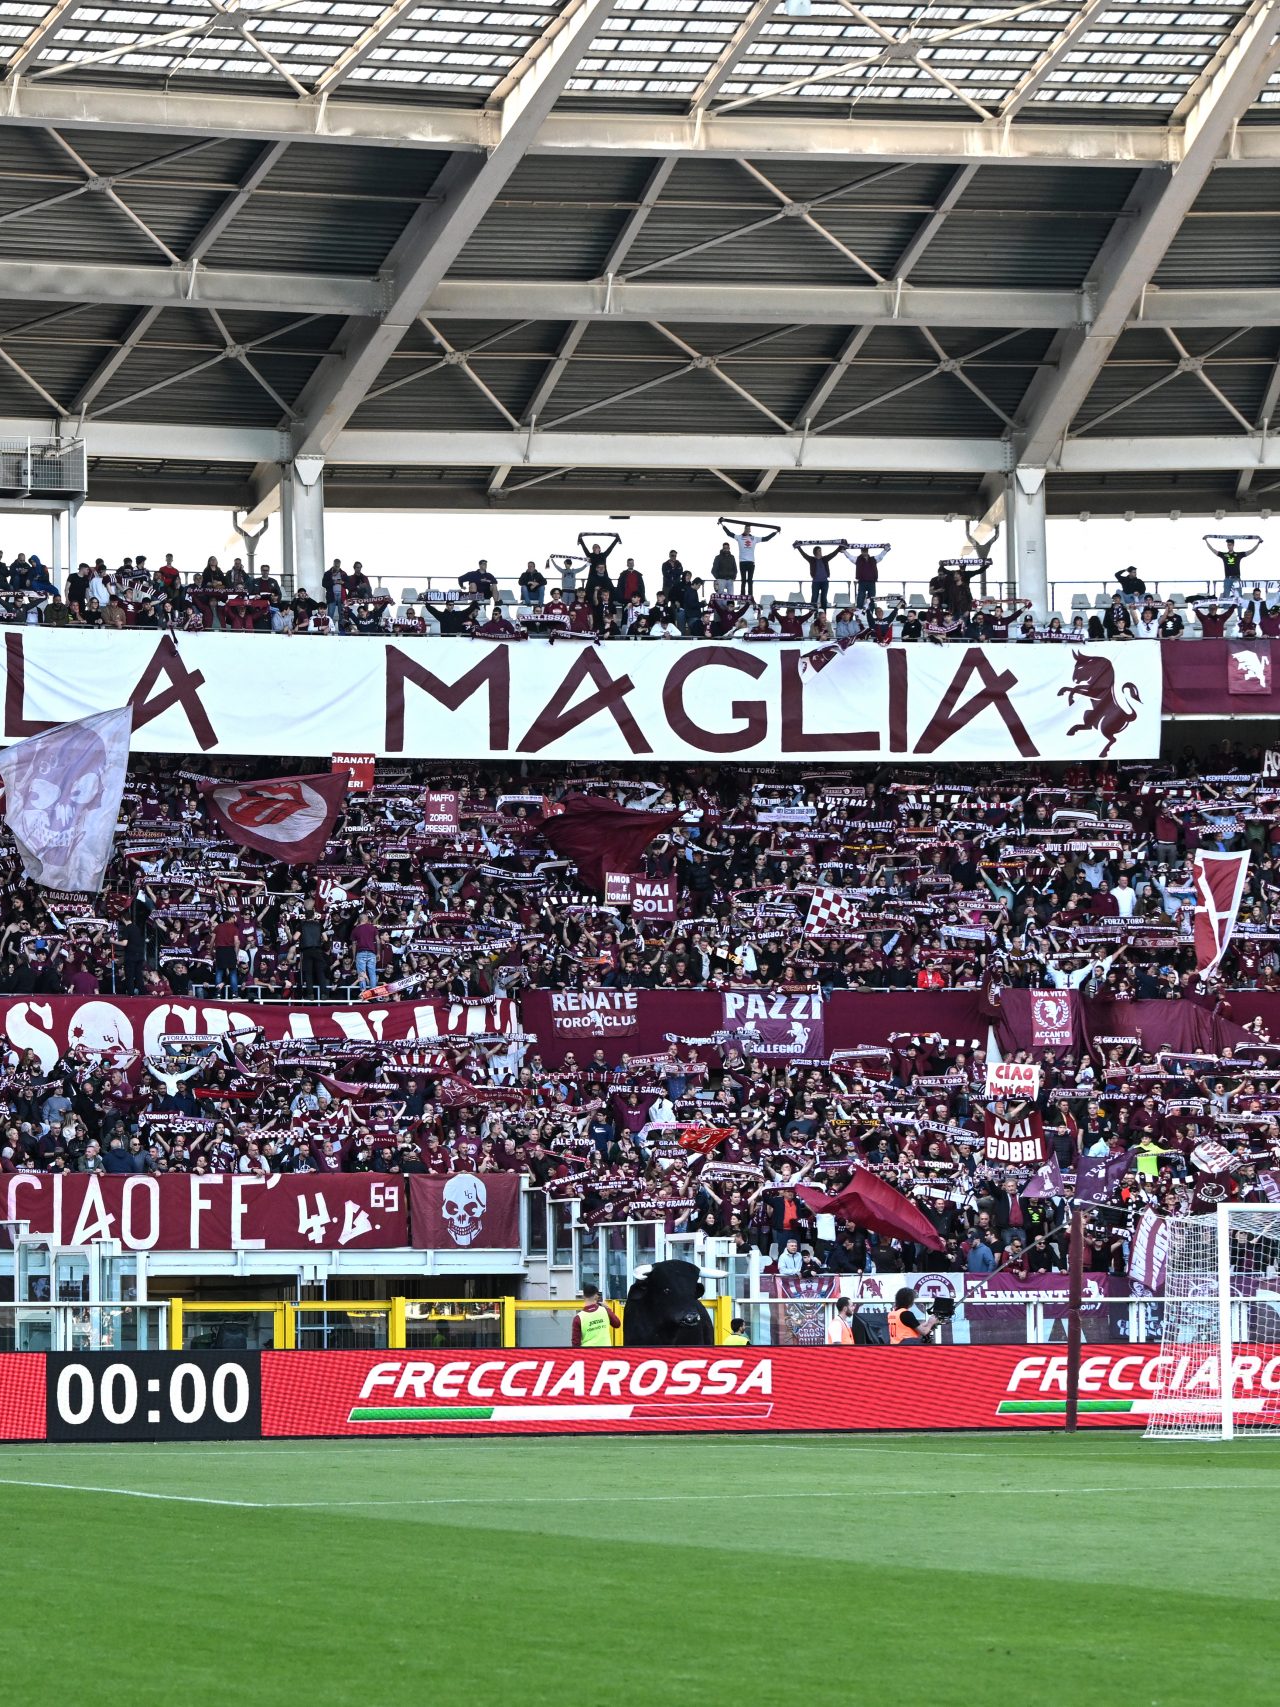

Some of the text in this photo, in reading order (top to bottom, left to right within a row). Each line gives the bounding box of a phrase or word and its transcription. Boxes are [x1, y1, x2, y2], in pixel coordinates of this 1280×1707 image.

[428, 592, 459, 601] FORZA TORO
[5, 632, 216, 750] LA
[385, 642, 1042, 758] MAGLIA
[430, 794, 455, 802] MAFFO
[440, 804, 445, 812] E
[425, 825, 458, 833] PRESENTI
[1045, 843, 1062, 851] JUVE
[1072, 843, 1087, 851] ODIO
[49, 892, 89, 901] MARATONA
[636, 883, 669, 897] MAI
[633, 899, 674, 913] SOLI
[552, 992, 638, 1012] RENATE
[725, 991, 821, 1019] PAZZI
[554, 1017, 591, 1028] TORO
[1102, 1036, 1137, 1045] GRANATA
[651, 1055, 669, 1063] TORO
[996, 1066, 1033, 1080] CIAO
[994, 1117, 1032, 1138] MAI
[987, 1137, 1043, 1162] GOBBI
[924, 1161, 954, 1169] TORINO
[370, 1182, 399, 1213] 69
[361, 1359, 774, 1398] FRECCIAROSSA
[57, 1362, 250, 1426] 00:00
